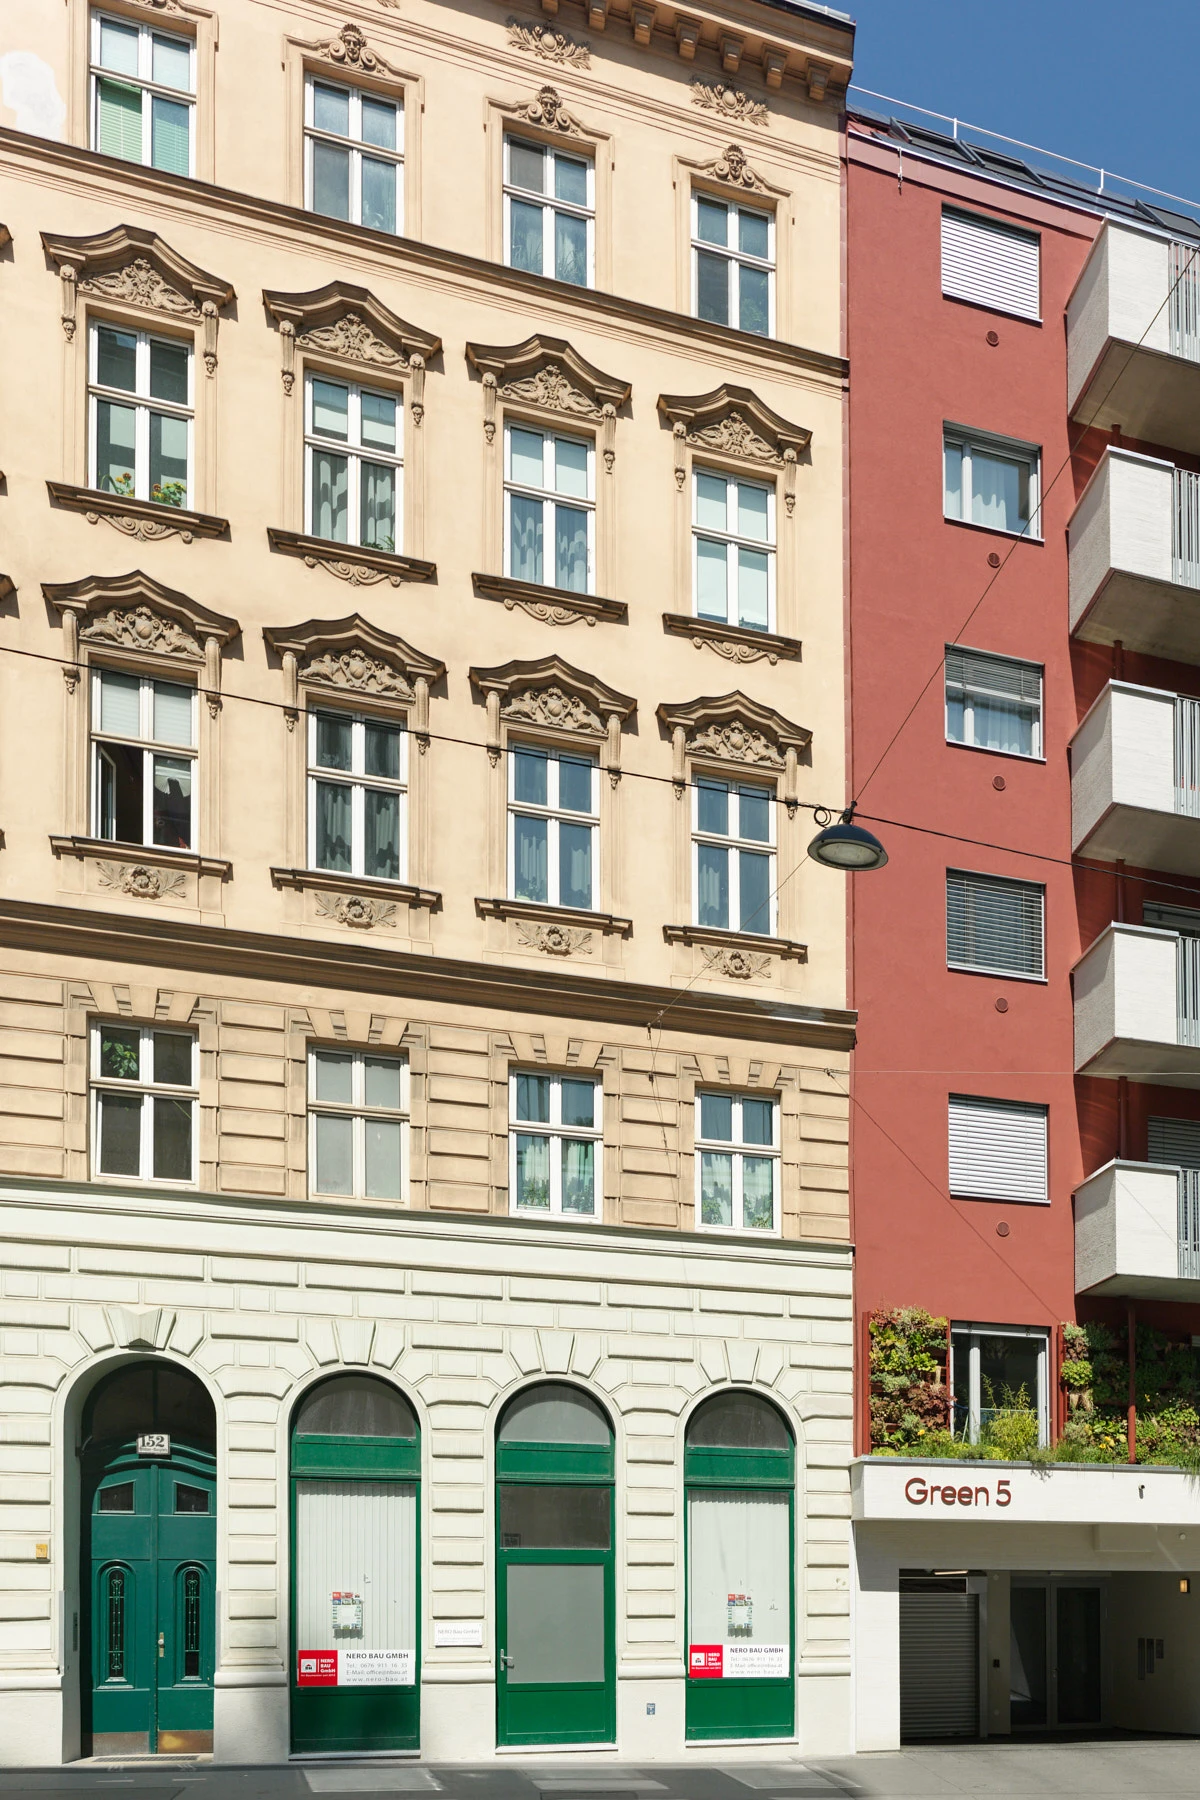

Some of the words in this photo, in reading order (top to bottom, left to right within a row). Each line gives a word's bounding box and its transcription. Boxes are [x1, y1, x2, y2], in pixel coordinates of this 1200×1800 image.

[141, 1435, 165, 1448] 152
[905, 1477, 989, 1506] Green
[996, 1480, 1012, 1507] 5
